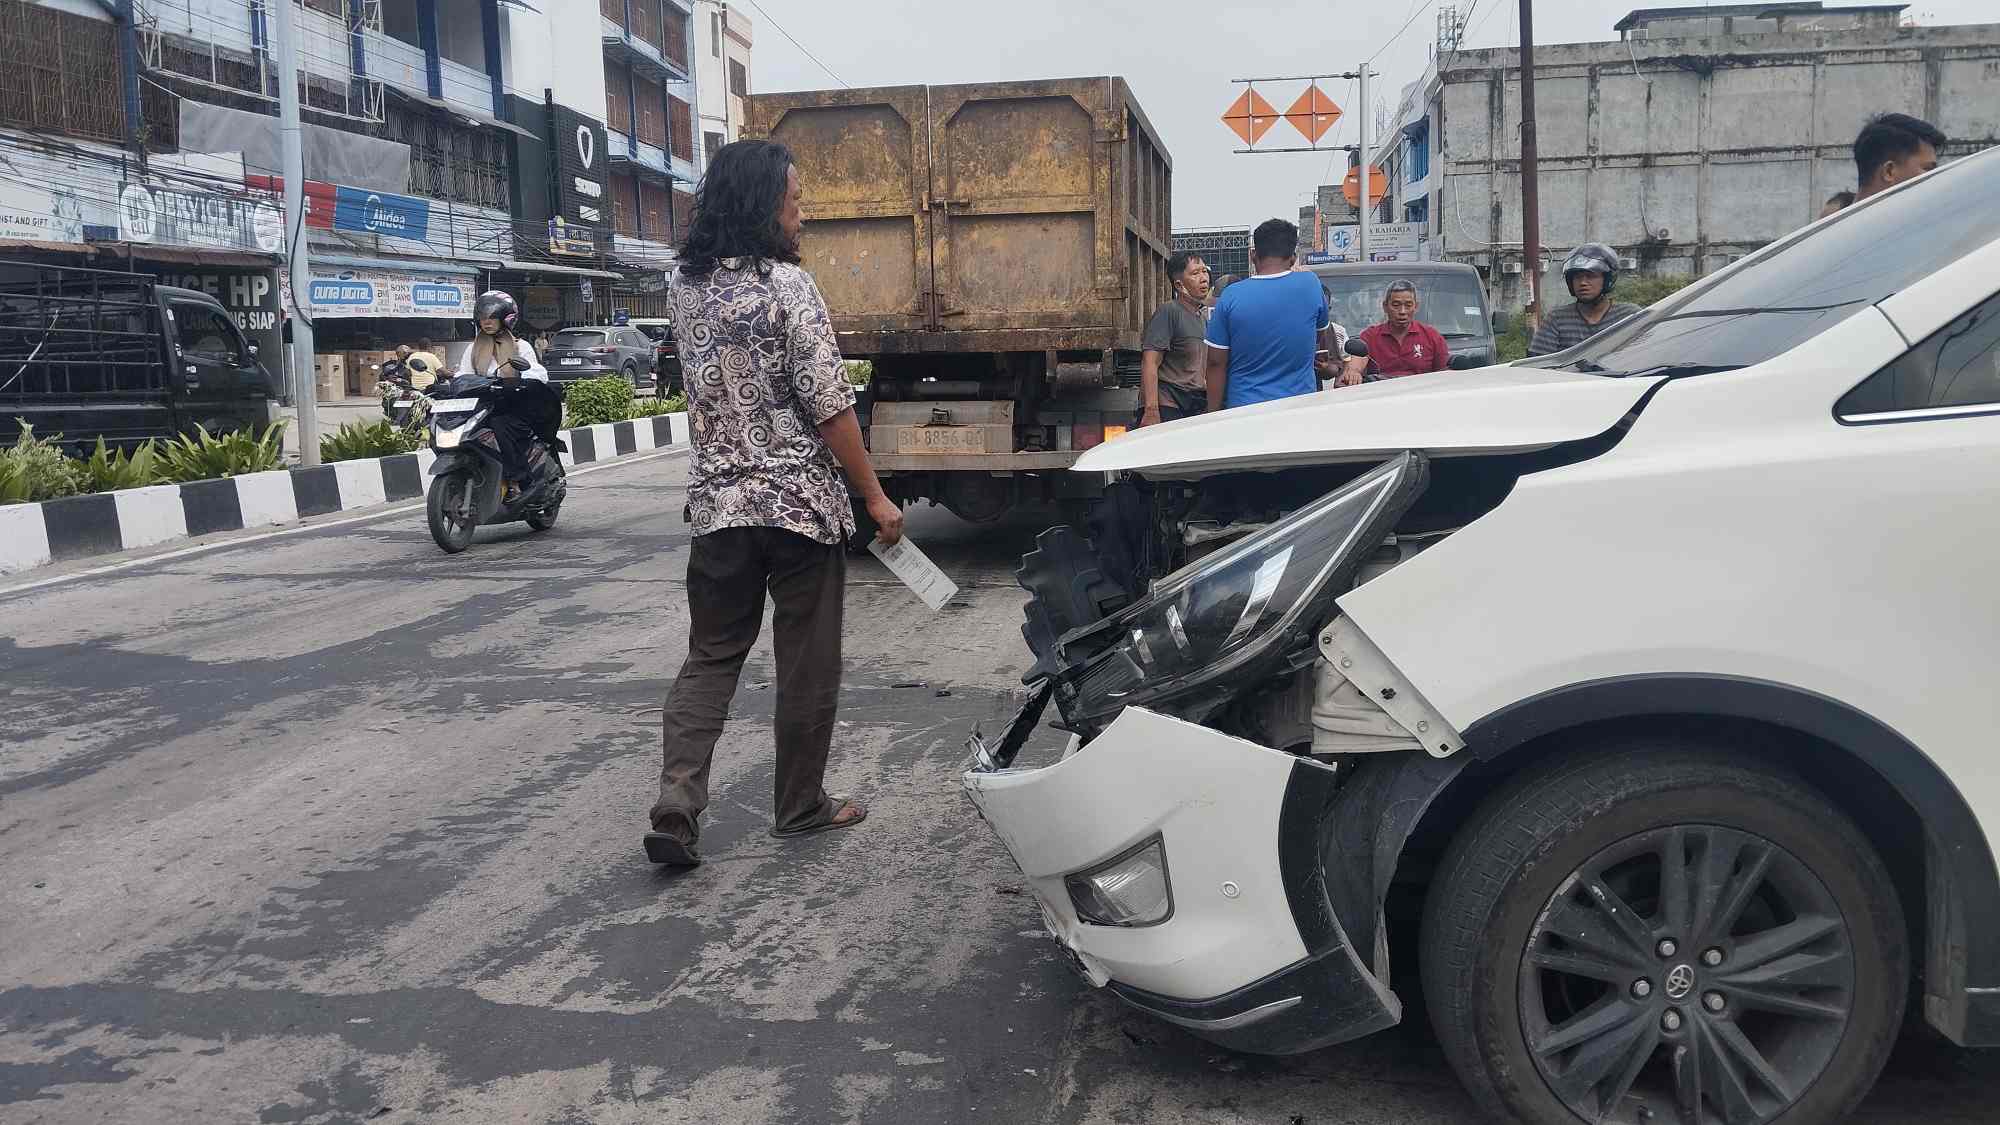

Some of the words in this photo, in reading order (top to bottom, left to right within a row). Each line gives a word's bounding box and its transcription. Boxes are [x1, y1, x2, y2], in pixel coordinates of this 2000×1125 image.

[15, 215, 31, 225] AND
[32, 217, 48, 226] GIFT
[371, 208, 405, 229] Midea
[229, 275, 269, 306] HP
[391, 283, 410, 292] SONY
[249, 311, 275, 330] SIAP
[924, 430, 959, 446] 8856
